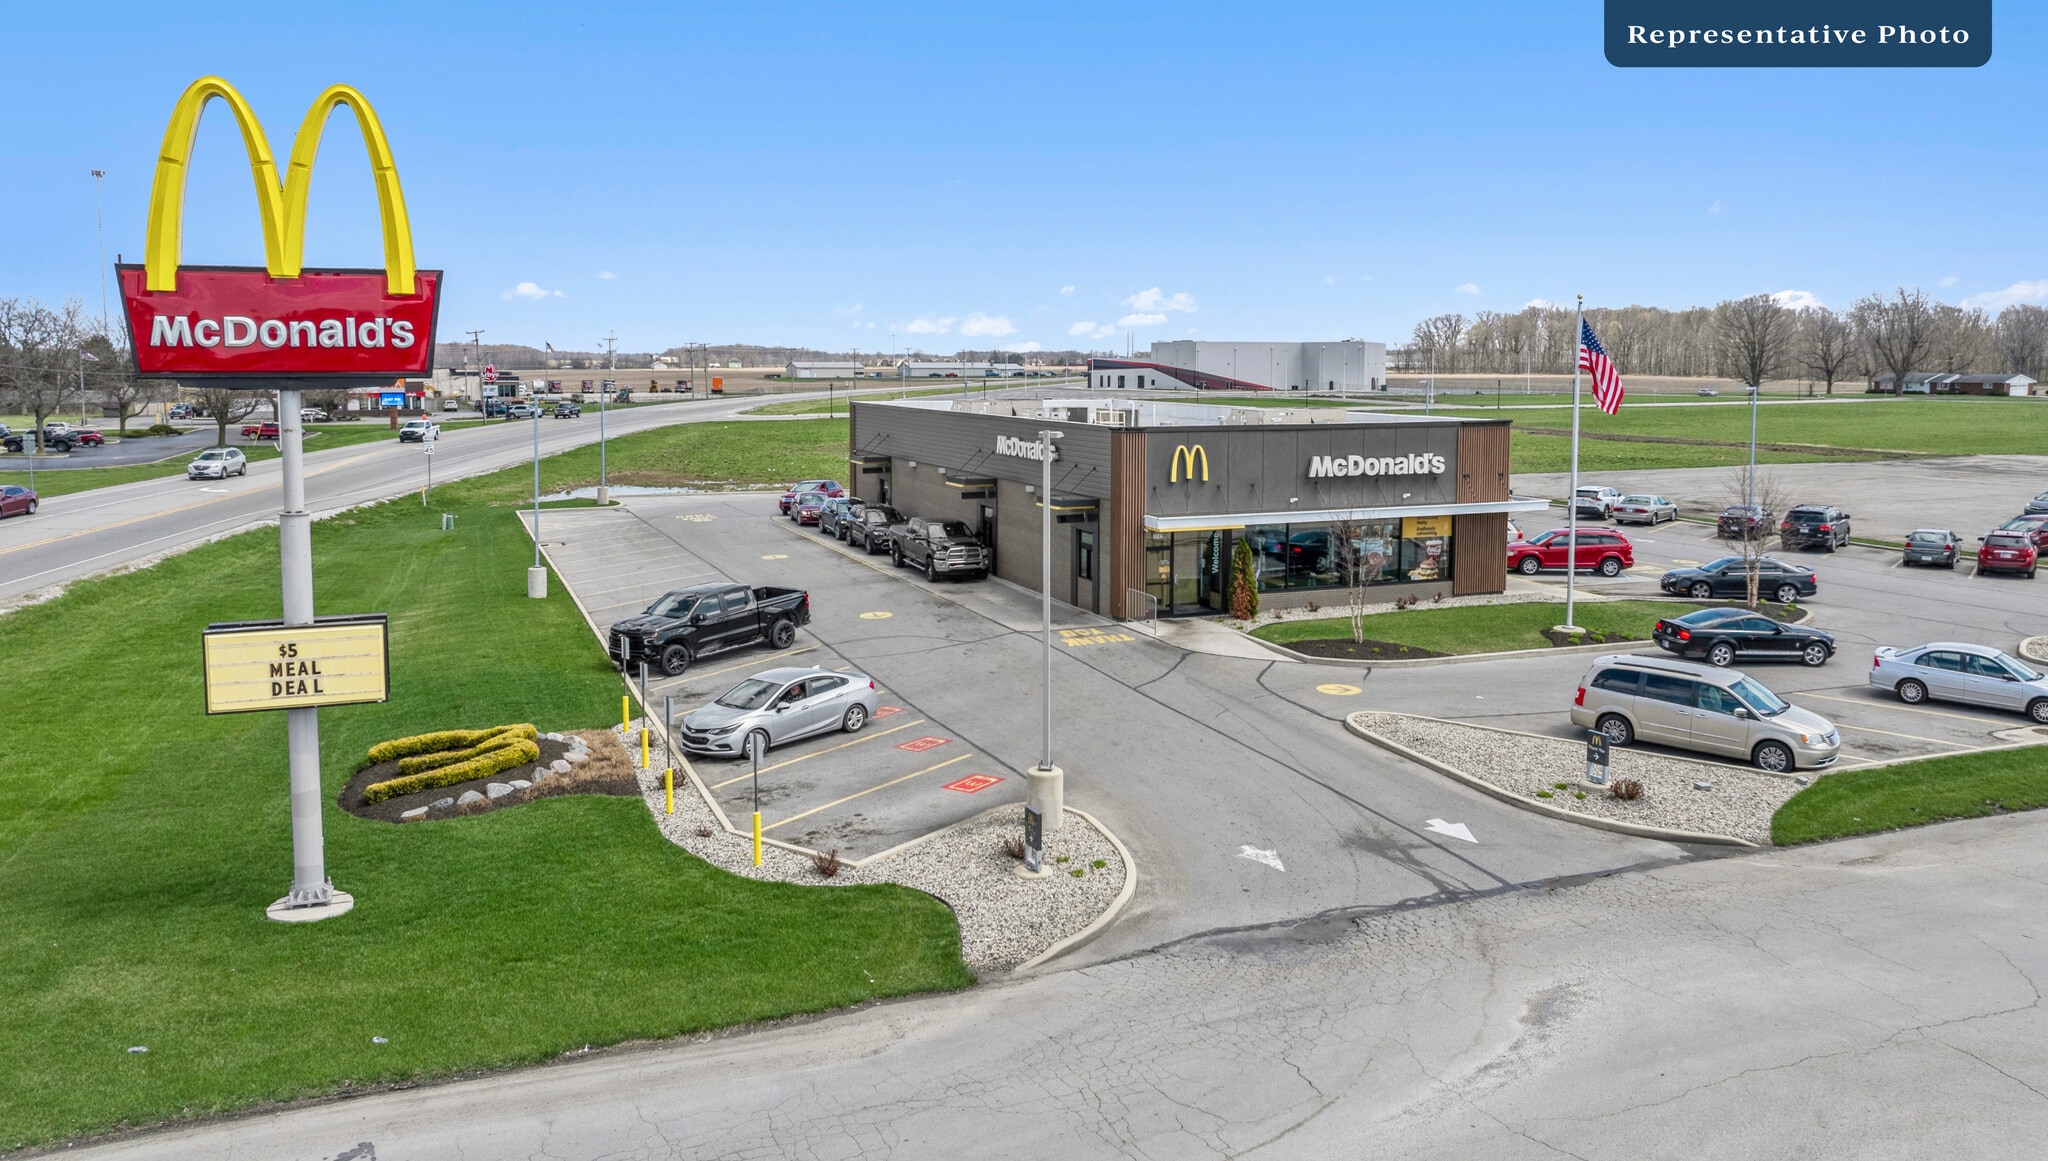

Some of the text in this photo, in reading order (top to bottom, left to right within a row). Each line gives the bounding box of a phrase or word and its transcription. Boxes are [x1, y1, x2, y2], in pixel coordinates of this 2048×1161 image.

[150, 315, 415, 348] McDonald's
[996, 435, 1057, 463] McDonals
[1308, 453, 1446, 477] McDonald's
[1211, 532, 1220, 574] Welcome
[1058, 627, 1105, 637] YOU
[1060, 633, 1136, 647] THANK
[278, 643, 298, 658] $5
[269, 660, 322, 678] MEAL
[271, 679, 323, 697] DEAL
